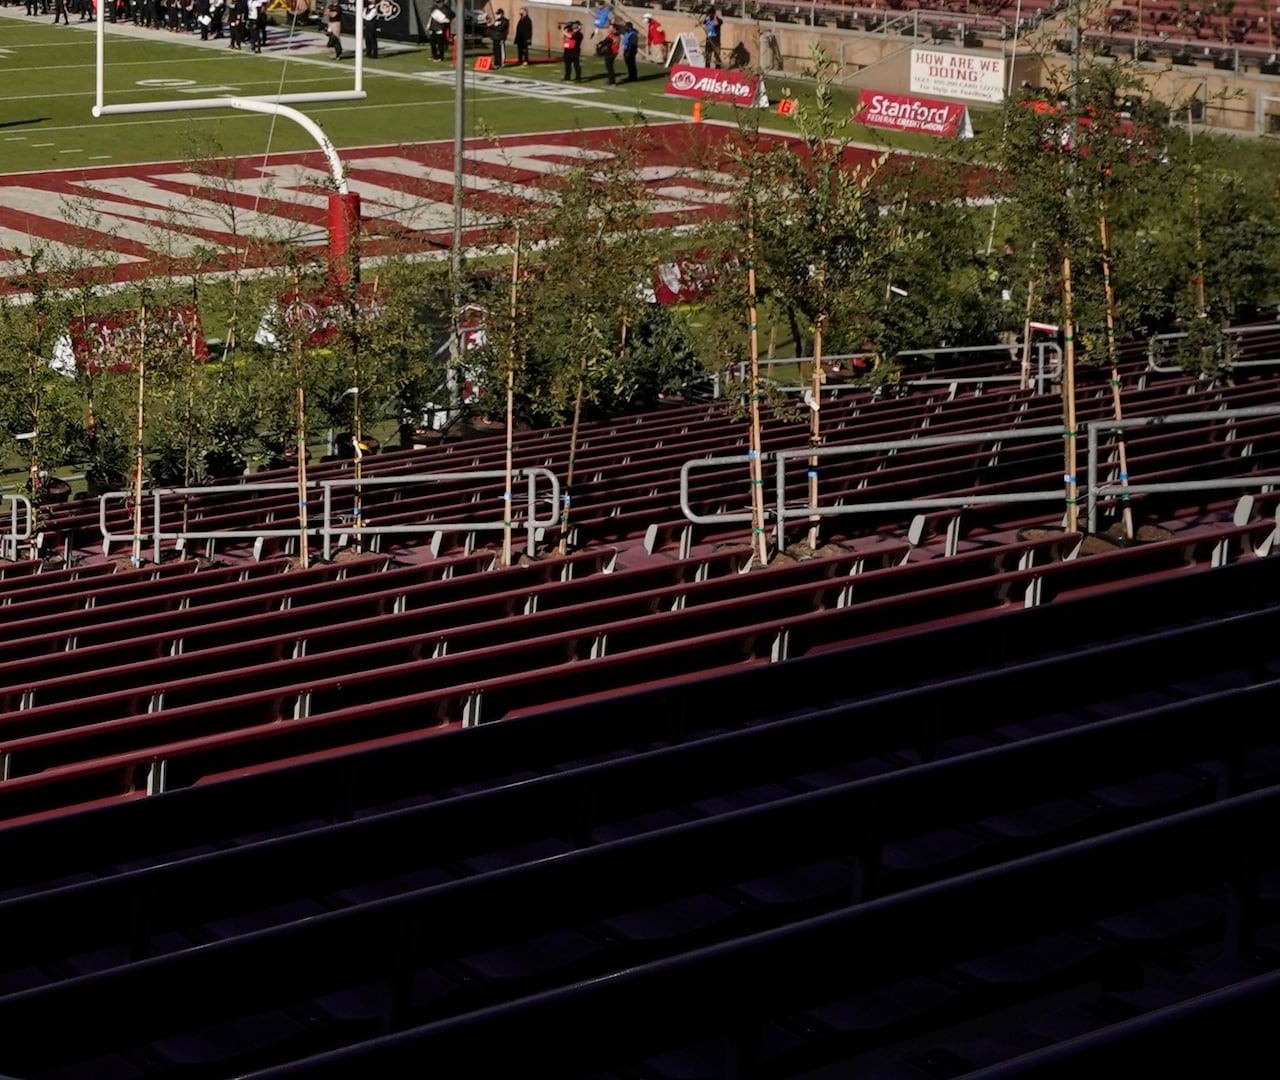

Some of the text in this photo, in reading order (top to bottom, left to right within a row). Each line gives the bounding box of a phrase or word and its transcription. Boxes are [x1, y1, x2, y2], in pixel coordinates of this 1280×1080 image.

[477, 58, 488, 68] 10
[916, 52, 1000, 72] HOW ARE WE
[928, 66, 985, 82] DOING?
[781, 103, 791, 112] G
[869, 95, 950, 123] Stanford
[867, 113, 896, 125] FEDERAL
[897, 117, 920, 129] CREDIT
